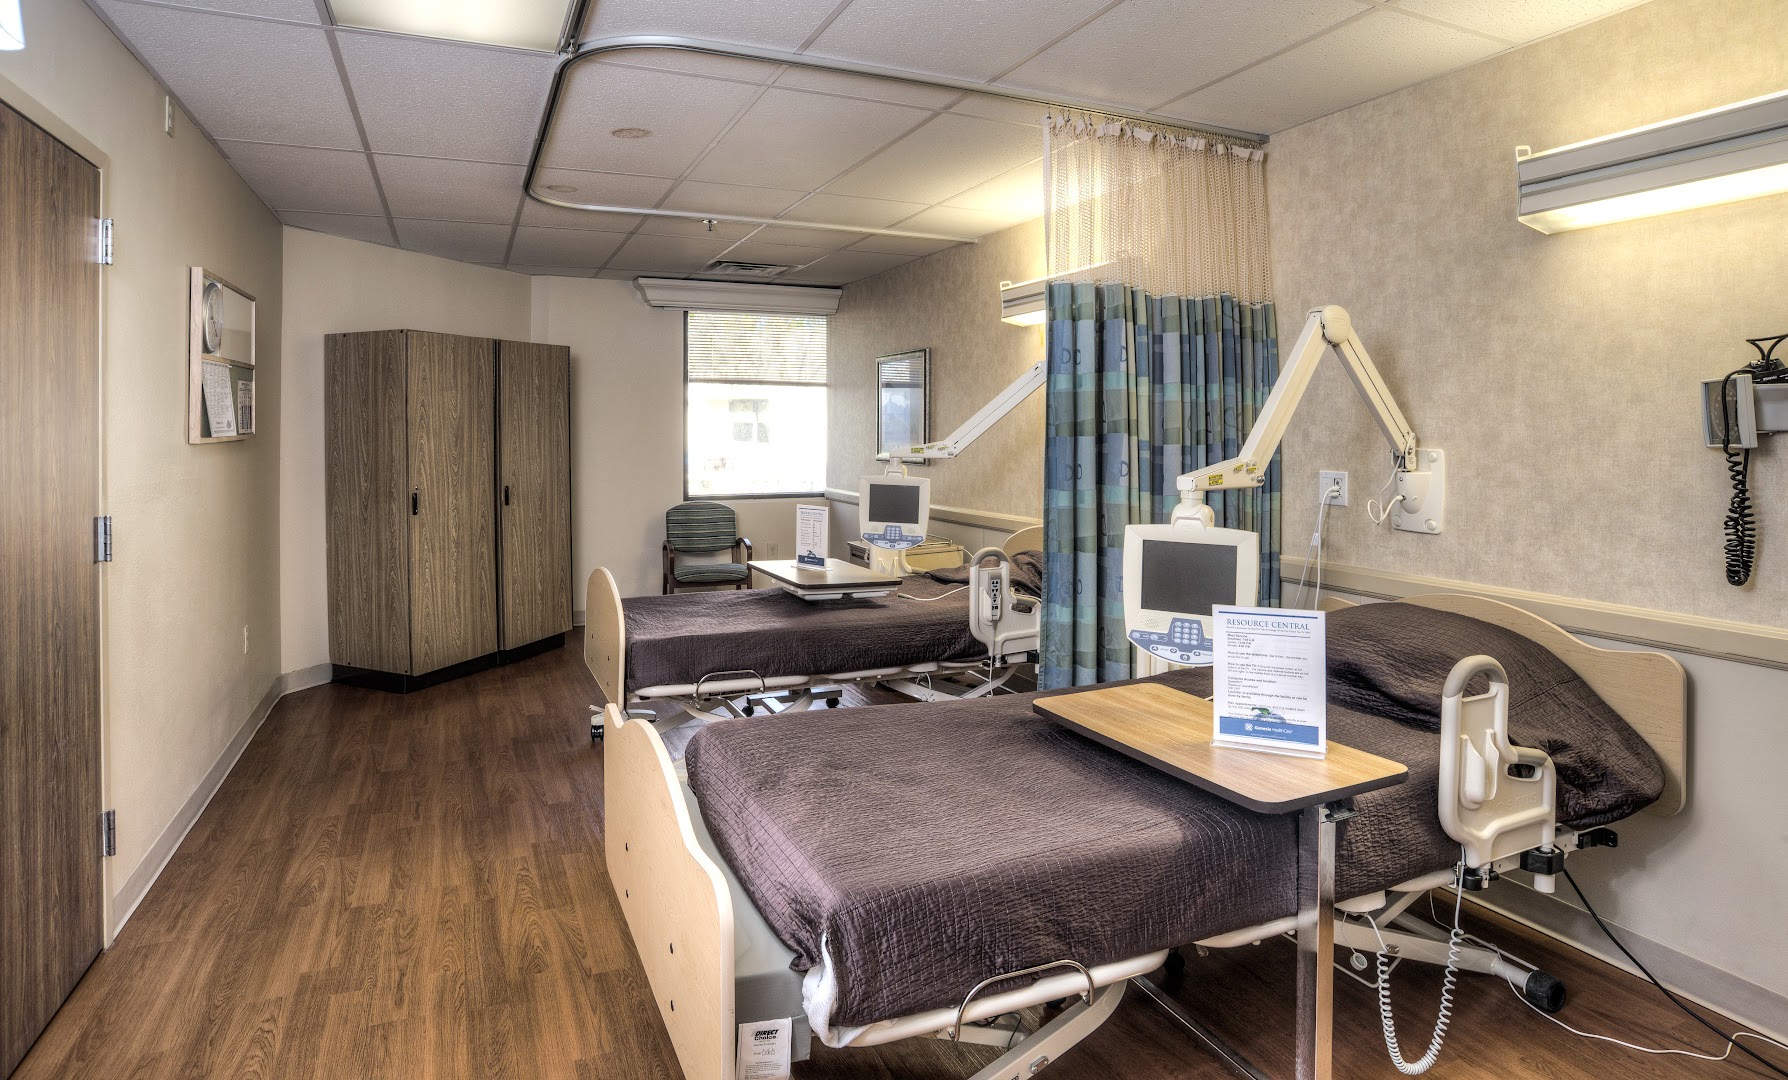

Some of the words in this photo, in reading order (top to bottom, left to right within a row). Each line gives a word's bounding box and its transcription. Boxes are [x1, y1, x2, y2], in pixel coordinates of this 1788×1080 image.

[1226, 618, 1270, 628] RESOURCE
[1271, 621, 1310, 630] CENTRAL
[755, 1029, 779, 1037] DIRECT
